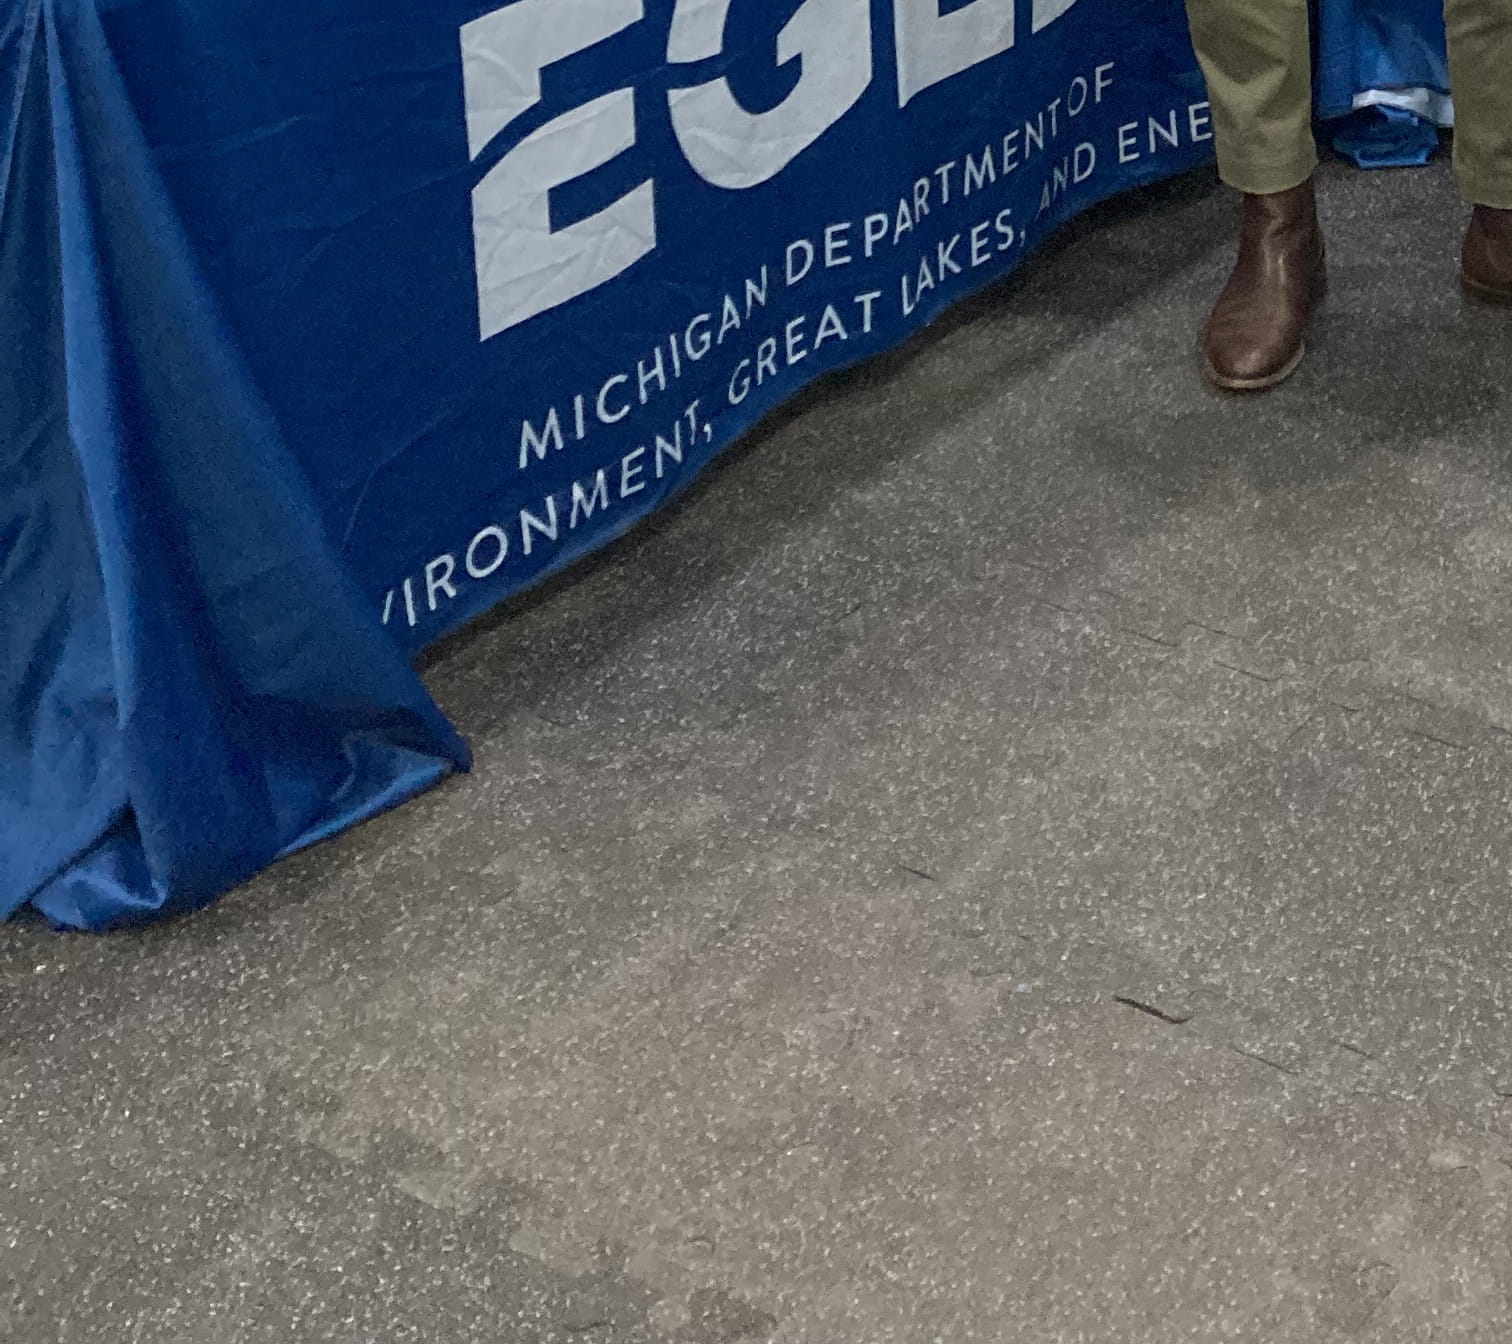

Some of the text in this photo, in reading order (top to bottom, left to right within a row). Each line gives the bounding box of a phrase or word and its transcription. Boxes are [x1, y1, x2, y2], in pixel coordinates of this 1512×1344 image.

[519, 62, 1115, 469] MICHIGAN DEPARTMENT OF
[727, 142, 1097, 405] GREAT LAKES, AND
